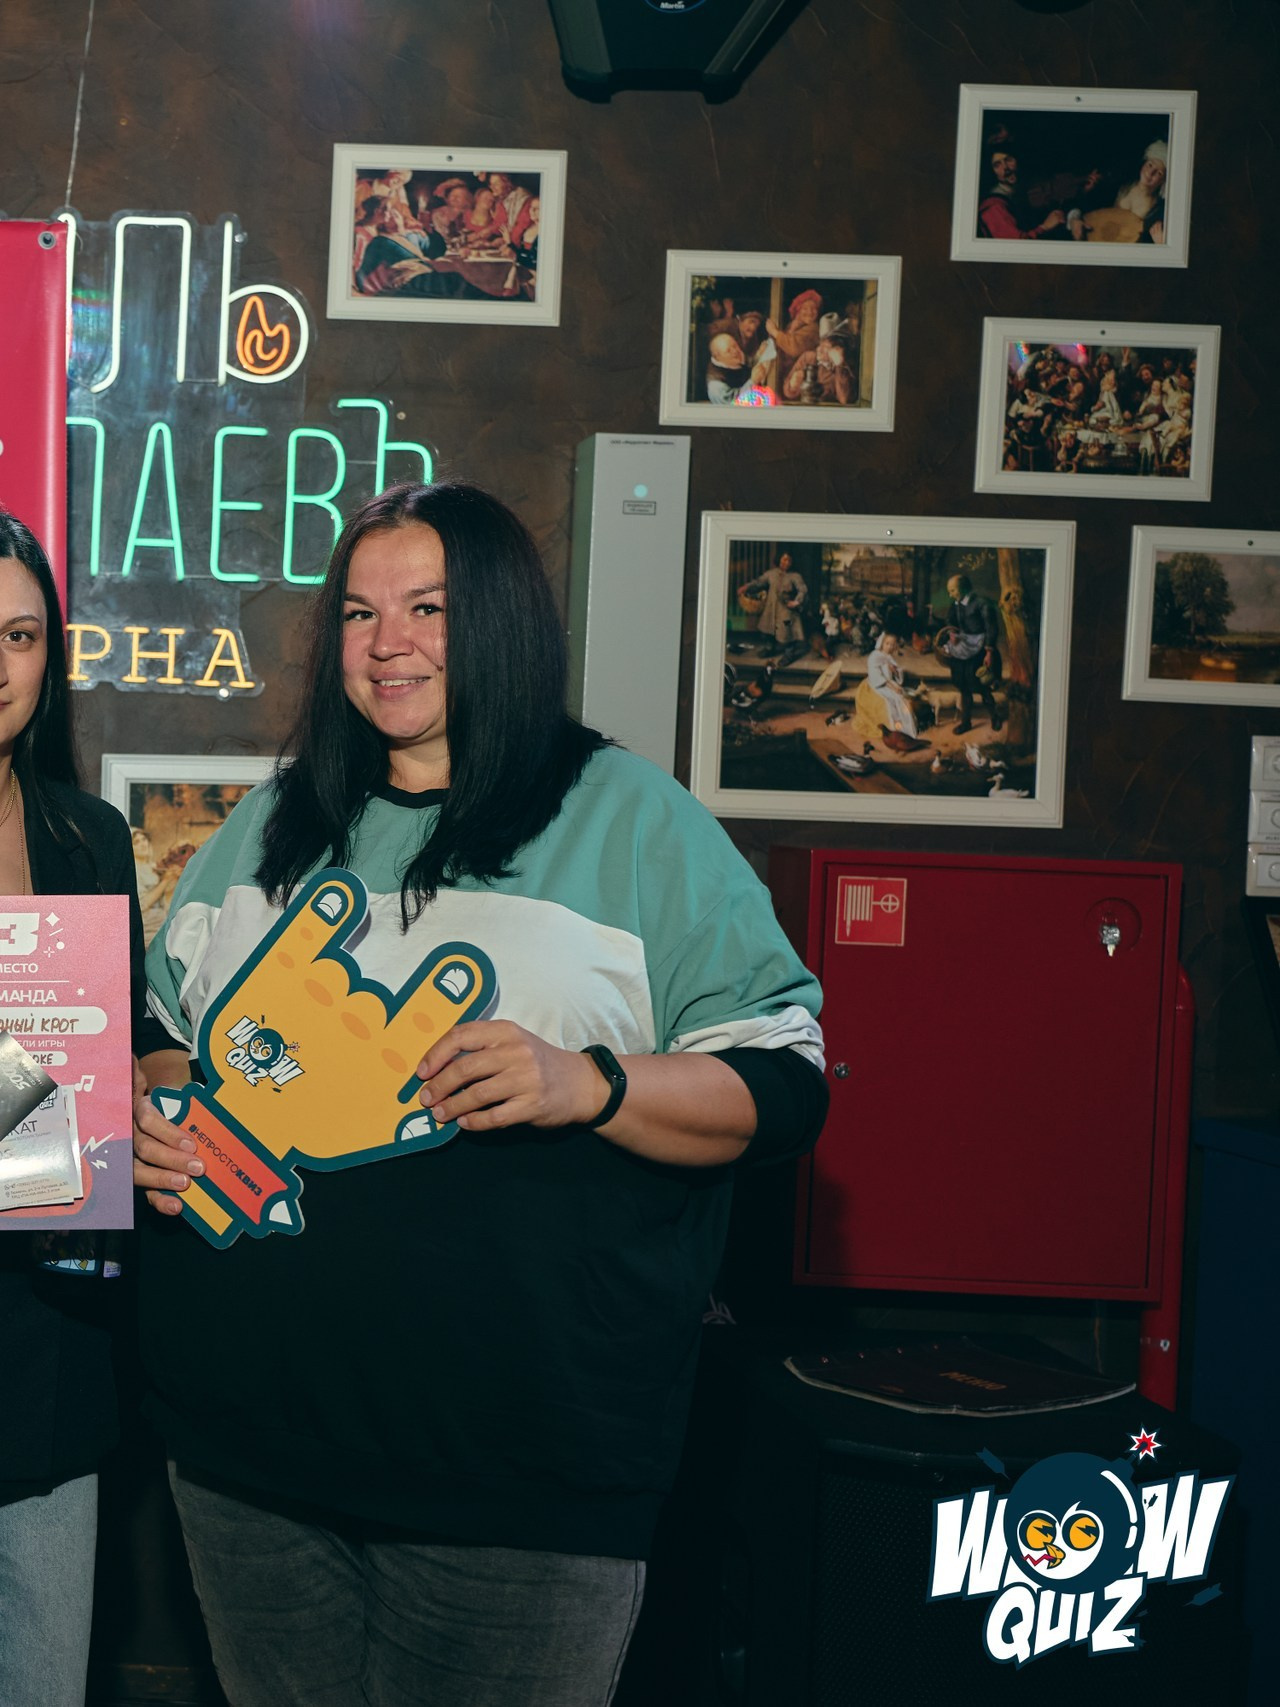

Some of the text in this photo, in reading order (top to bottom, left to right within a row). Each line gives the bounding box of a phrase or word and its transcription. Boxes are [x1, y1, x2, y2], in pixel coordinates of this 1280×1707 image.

[38, 1039, 65, 1048] ИГРЫ
[225, 1047, 269, 1087] QUIZ
[188, 1123, 263, 1198] #НЕПРОСТОКВИЗ
